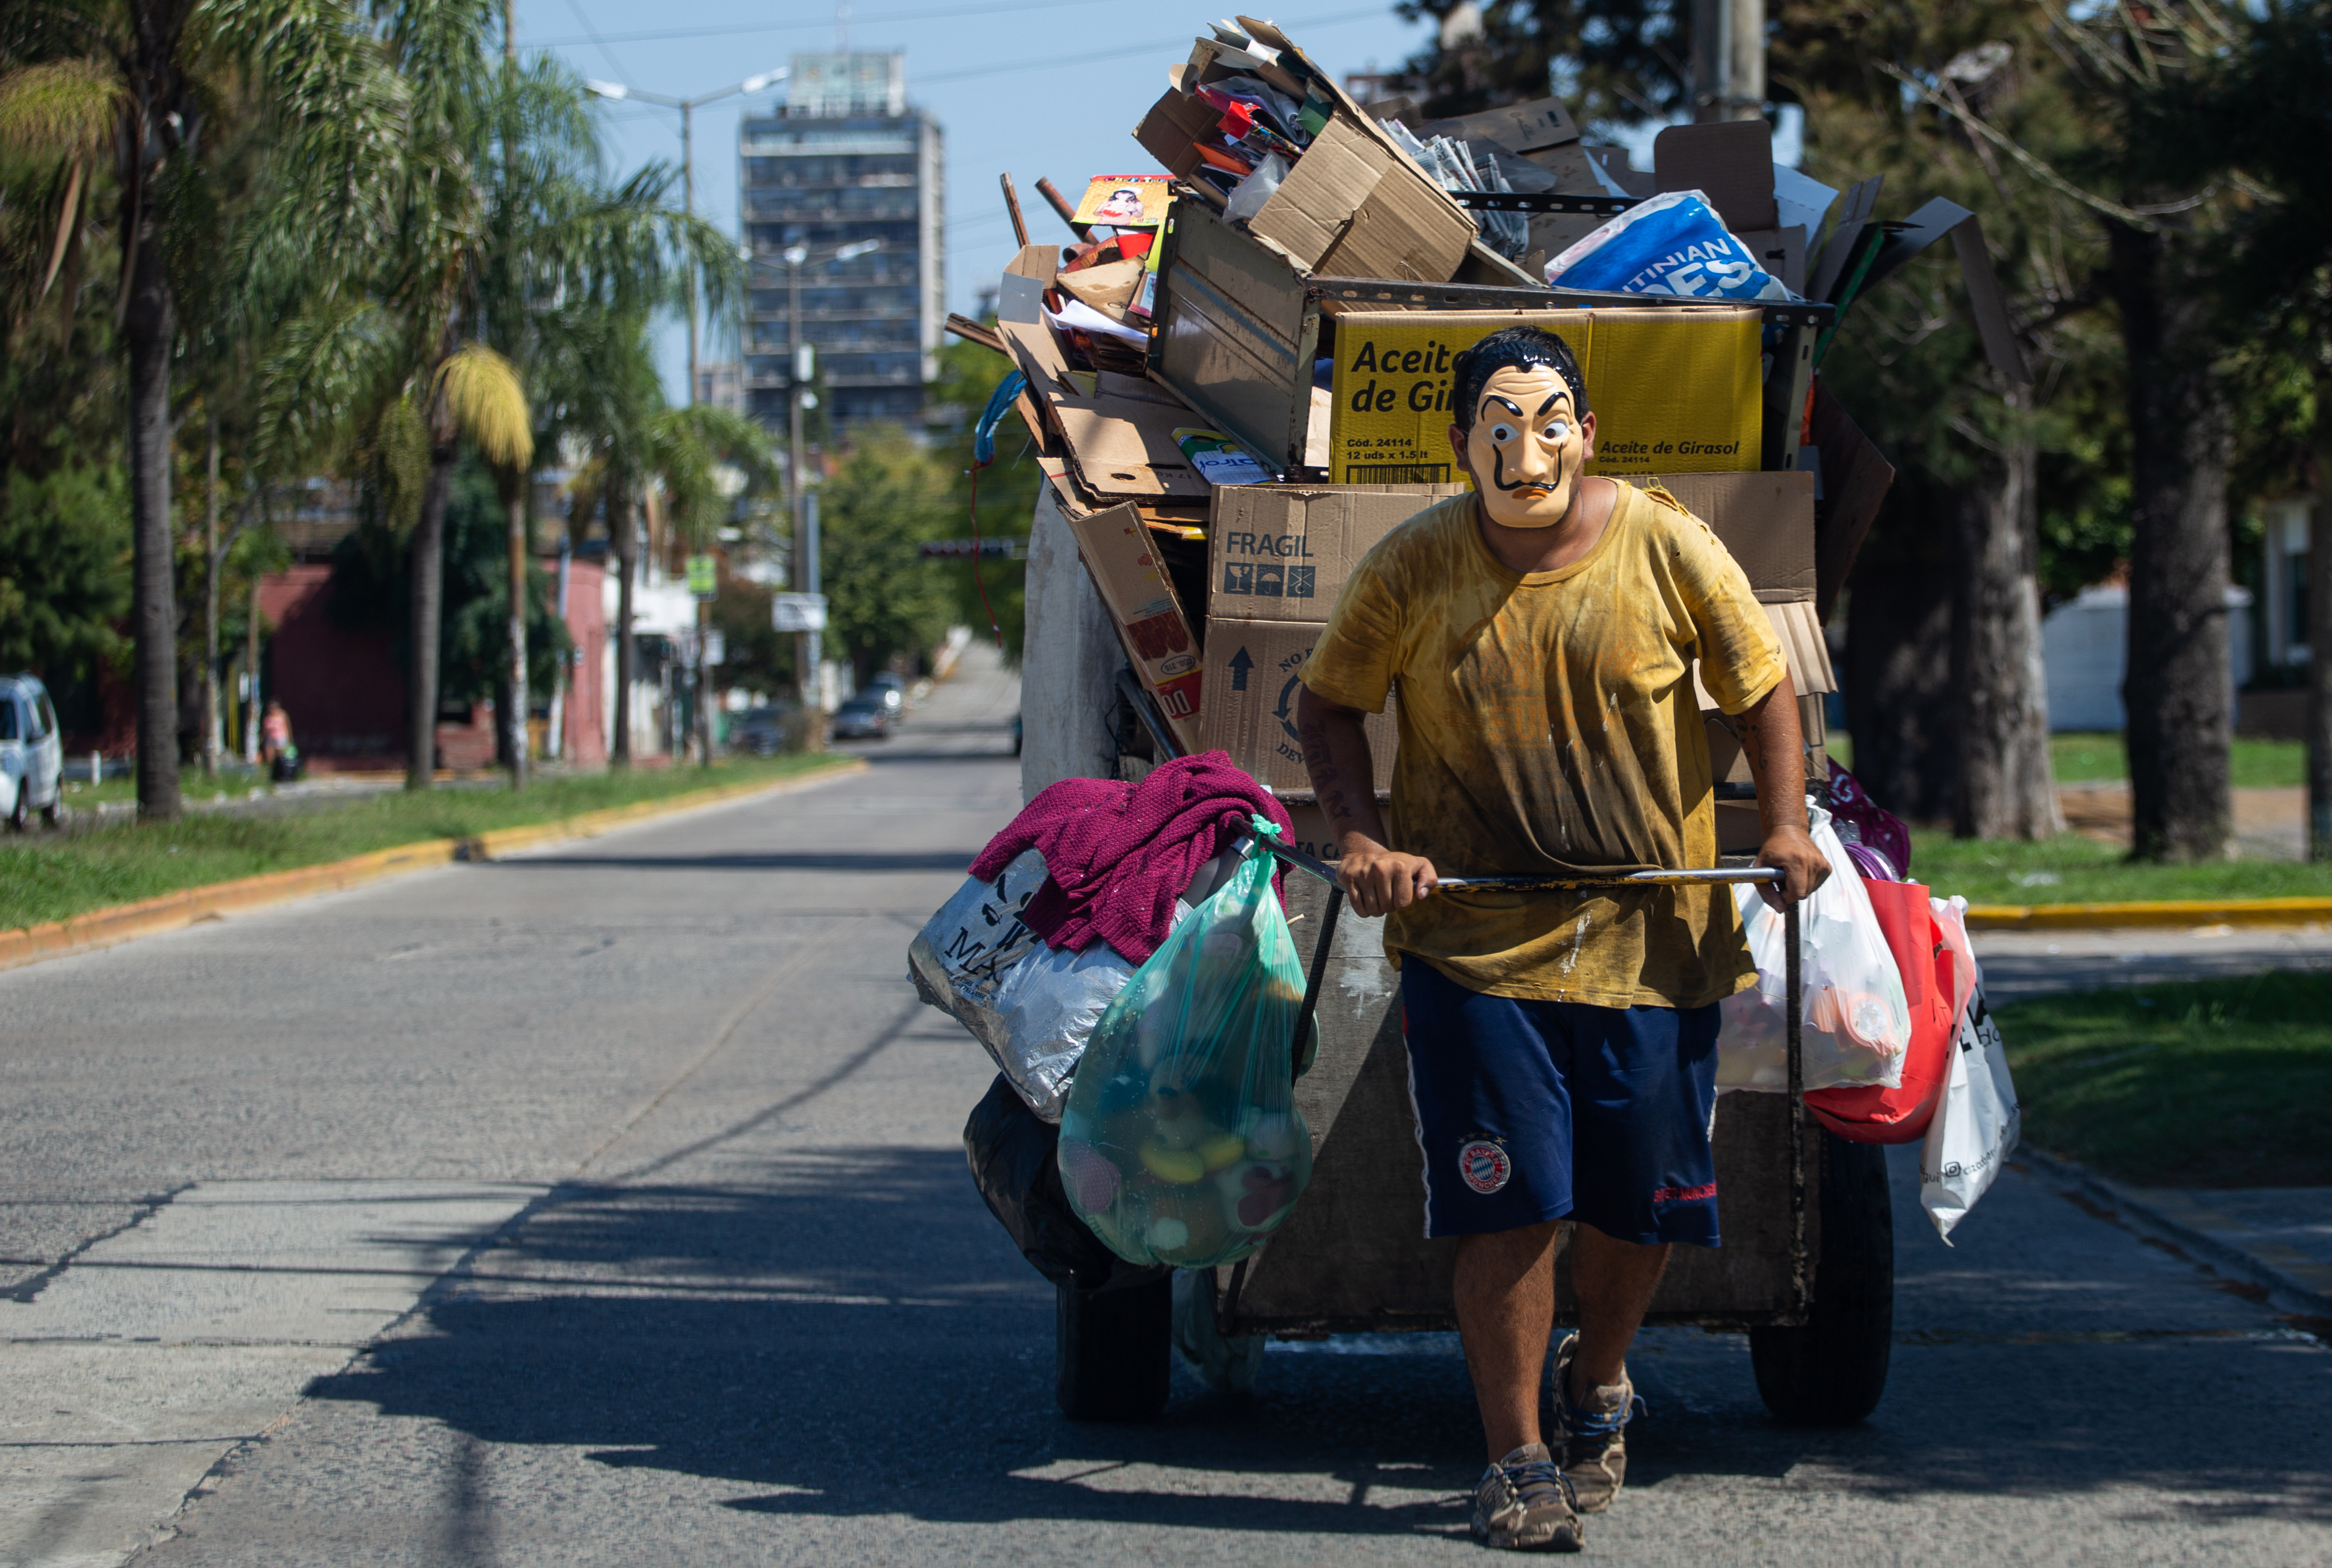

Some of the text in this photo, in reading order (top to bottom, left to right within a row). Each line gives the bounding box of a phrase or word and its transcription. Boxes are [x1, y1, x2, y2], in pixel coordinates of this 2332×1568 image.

[1351, 379, 1396, 413] de
[1347, 438, 1412, 447] Cód. 24114
[1599, 440, 1740, 455] Aceite de Girasol
[1347, 451, 1360, 459] 12
[1364, 451, 1385, 459] uds
[1399, 451, 1417, 459] 1.5
[1420, 450, 1428, 459] lt
[1226, 532, 1314, 558] FRAGIL
[1278, 653, 1302, 673] NO
[1470, 1149, 1500, 1165] BAYERN
